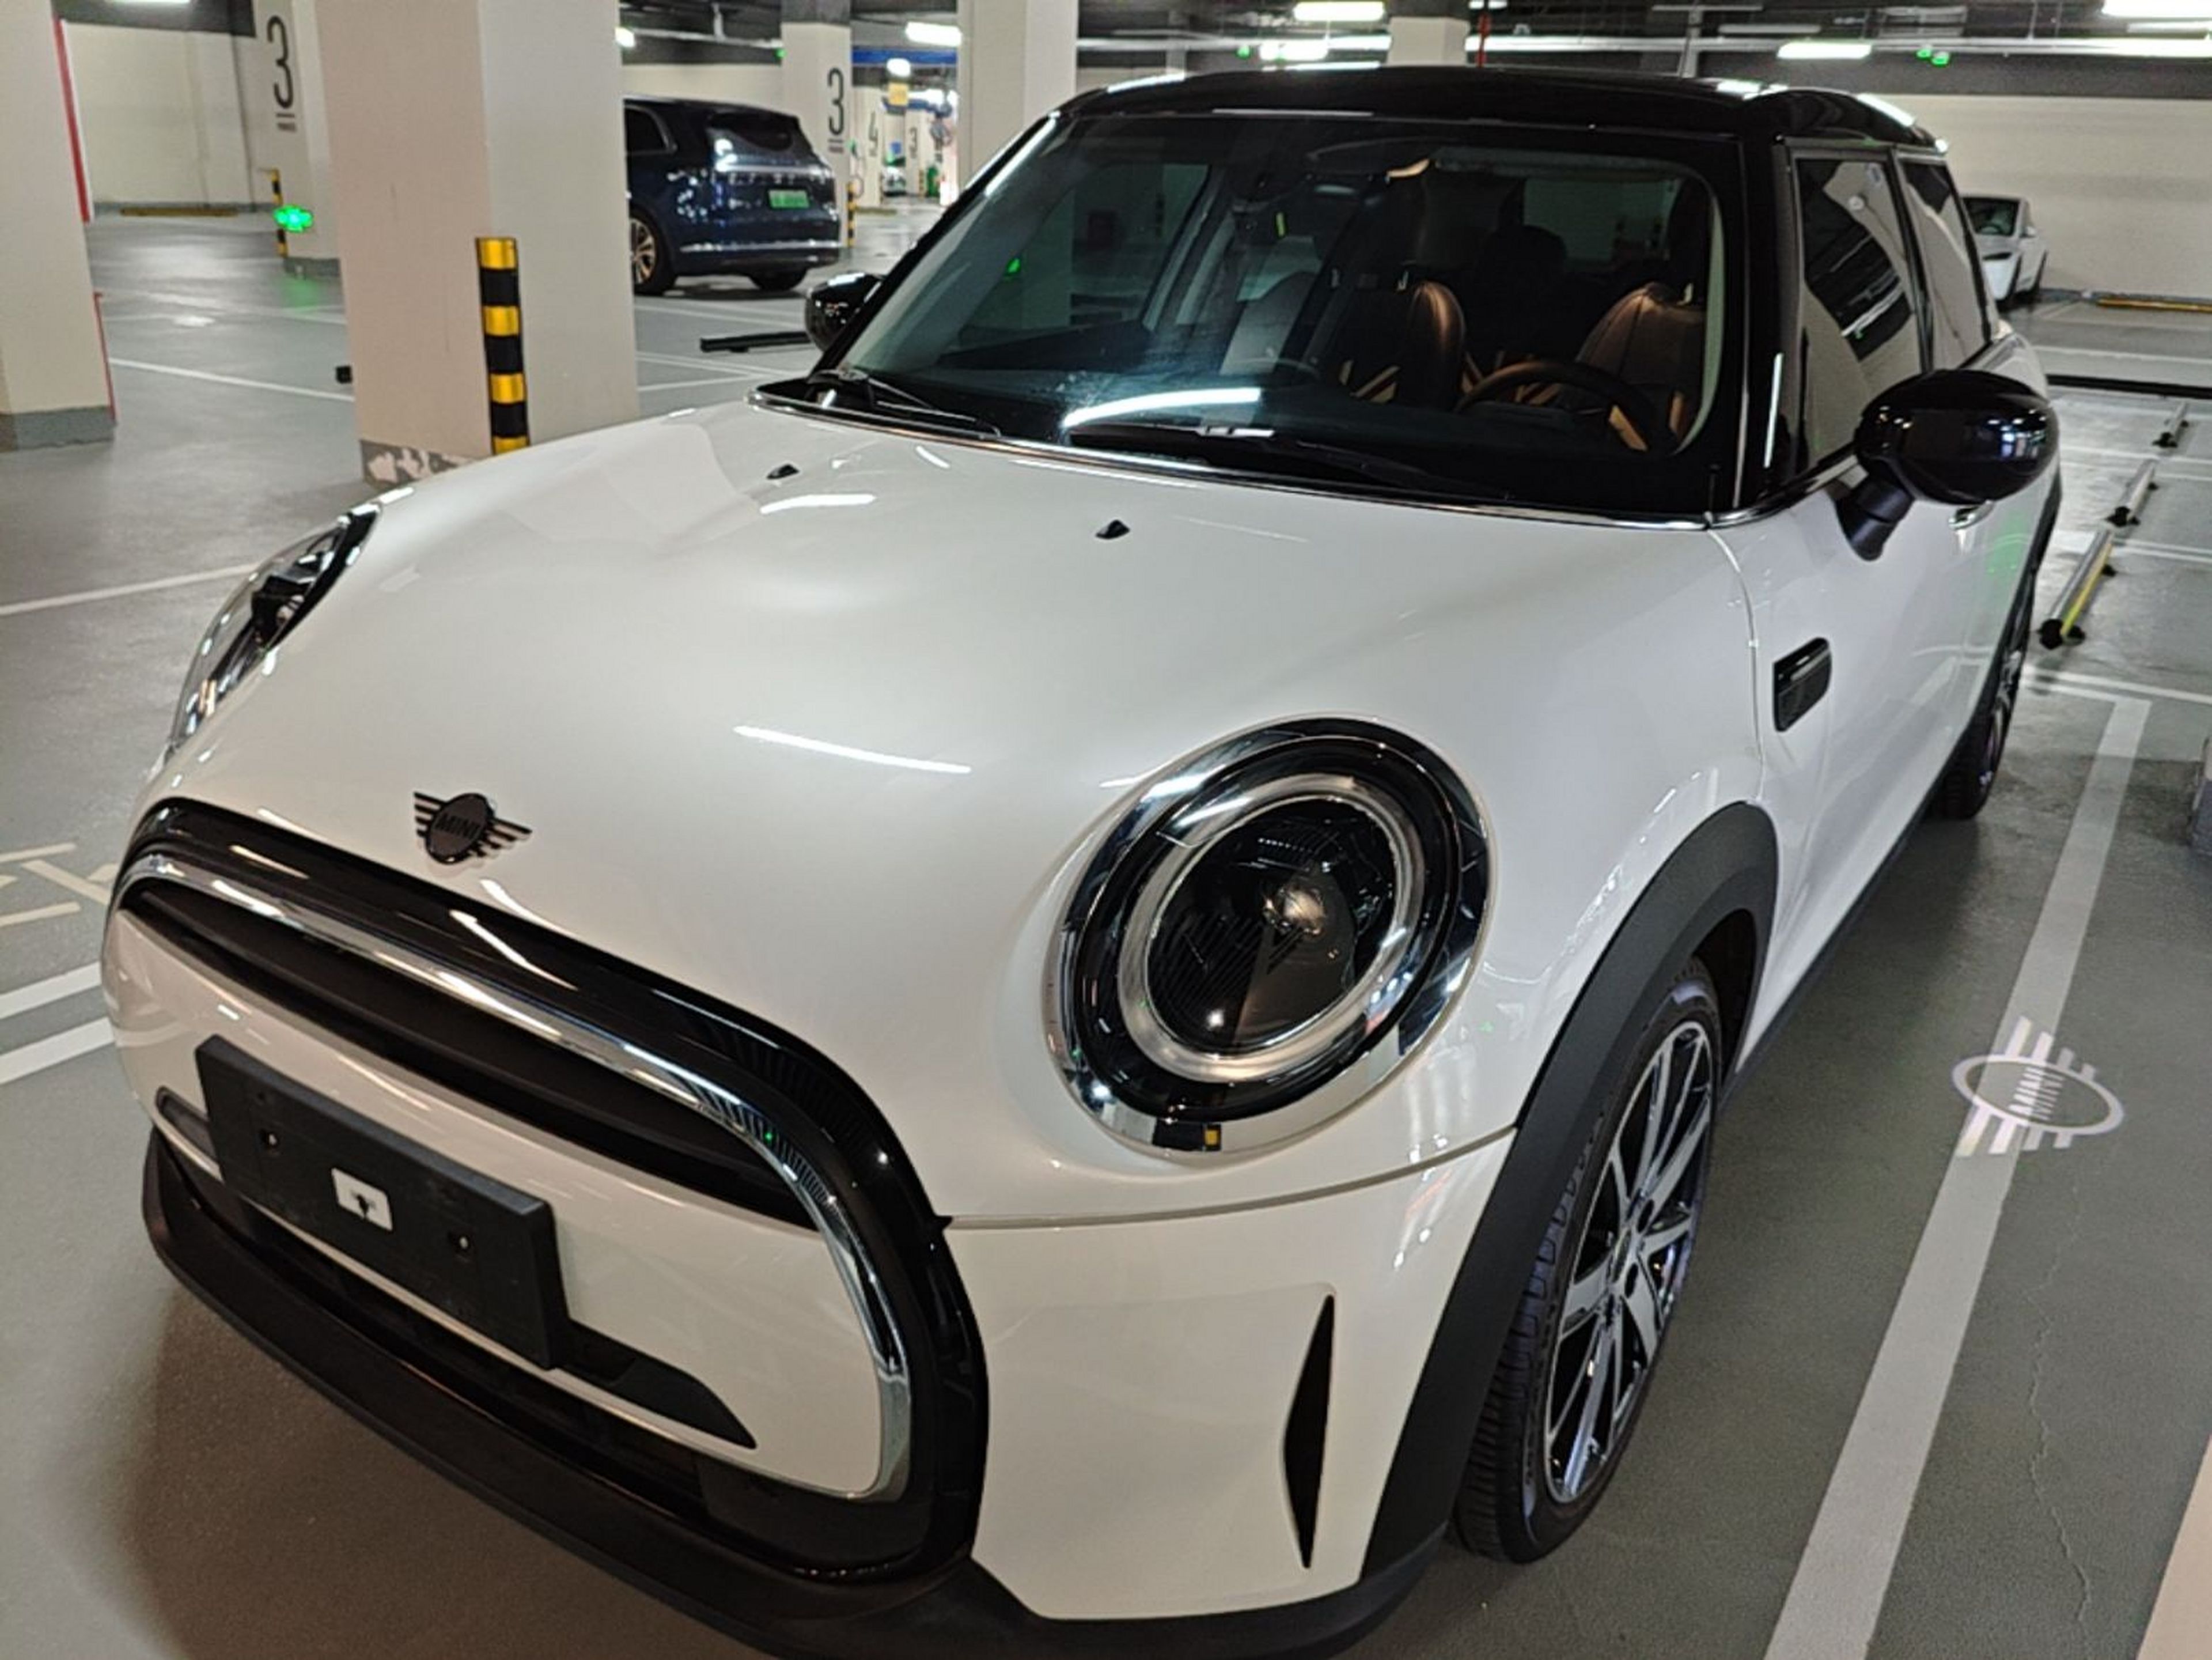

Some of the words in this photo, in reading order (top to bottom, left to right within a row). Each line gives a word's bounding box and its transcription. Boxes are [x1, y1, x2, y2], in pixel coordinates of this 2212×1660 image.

[267, 14, 293, 109] 3
[827, 67, 844, 135] 3
[435, 812, 480, 840] MINI
